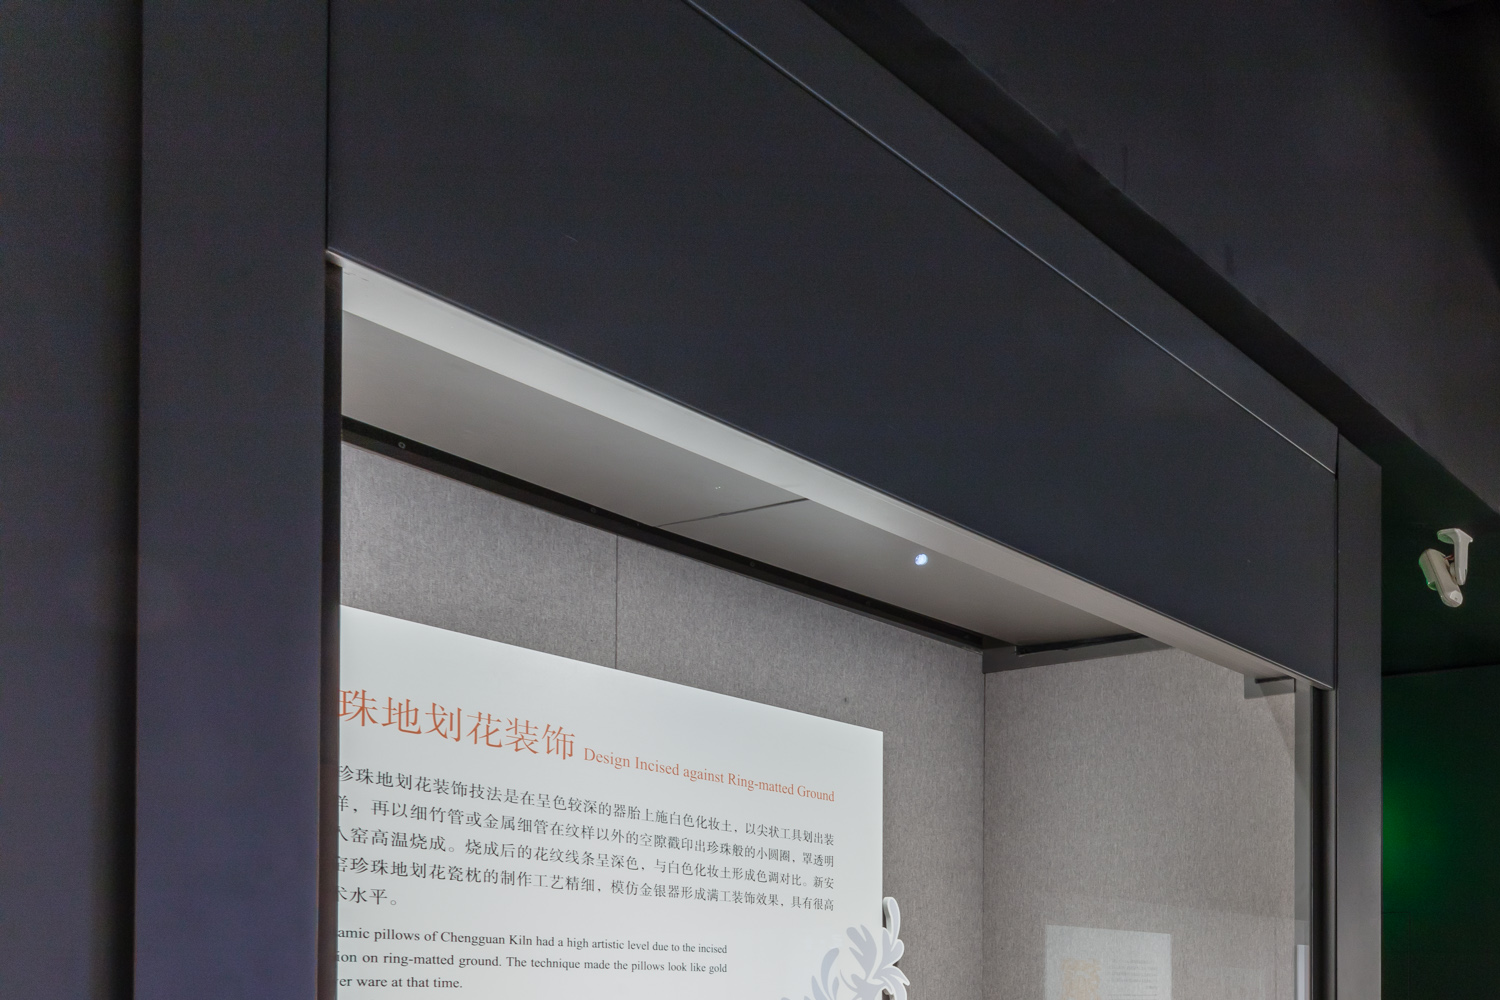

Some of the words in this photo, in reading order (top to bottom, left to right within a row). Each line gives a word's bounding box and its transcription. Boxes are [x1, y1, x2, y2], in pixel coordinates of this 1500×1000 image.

[339, 689, 576, 761] 珠地划花装饰
[583, 747, 631, 770] Design
[635, 756, 680, 776] Incised
[683, 767, 725, 783] against
[727, 773, 795, 796] Ring-matted
[797, 784, 835, 802] Ground
[374, 928, 421, 942] pillows
[424, 930, 438, 942] of
[440, 931, 506, 947] Chengguan
[509, 934, 533, 946] Kiln
[536, 936, 555, 947] had
[557, 939, 564, 947] a
[567, 937, 589, 950] high
[592, 939, 625, 950] artistic
[627, 940, 650, 951] level
[652, 941, 669, 952] due
[671, 943, 680, 952] to
[682, 943, 696, 953] the
[698, 943, 728, 954] incised
[362, 953, 378, 964] on
[383, 952, 454, 967] ring-matted
[458, 956, 502, 969] ground.
[506, 956, 527, 968] The
[530, 958, 581, 971] technique
[584, 960, 610, 970] made
[613, 960, 628, 970] the
[631, 960, 665, 973] pillows
[668, 961, 687, 972] look
[690, 962, 706, 972] like
[708, 963, 728, 975] gold
[356, 979, 388, 988] ware
[391, 977, 403, 988] at
[406, 977, 430, 988] that
[433, 977, 463, 988] time.
